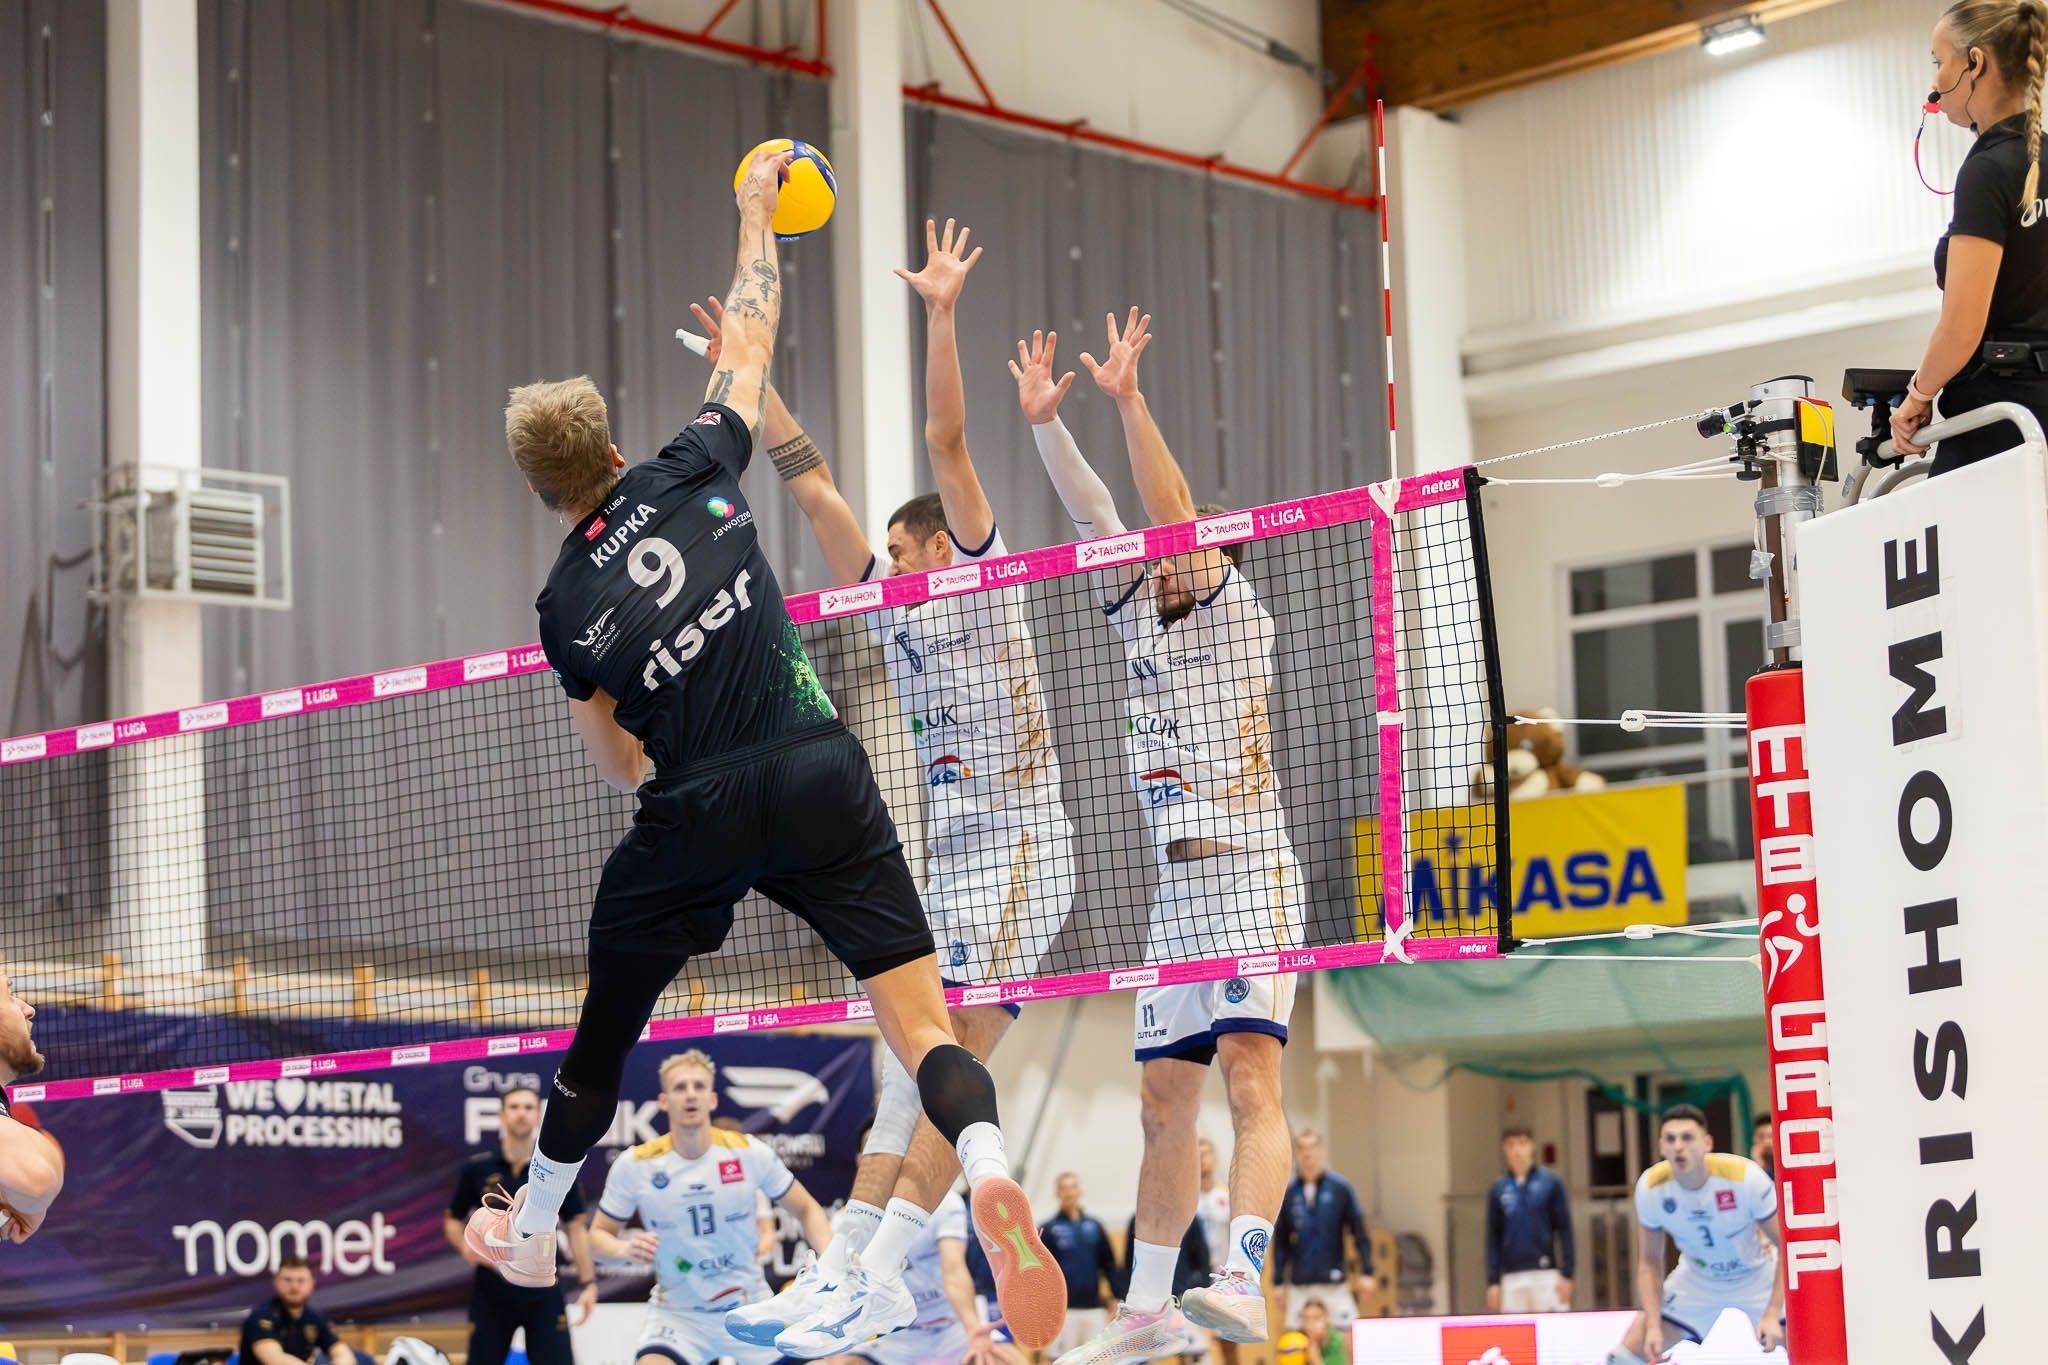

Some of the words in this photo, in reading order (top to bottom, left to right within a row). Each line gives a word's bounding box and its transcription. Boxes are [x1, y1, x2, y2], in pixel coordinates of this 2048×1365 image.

[1421, 478, 1460, 496] netex
[609, 495, 627, 511] LIGA
[1214, 521, 1250, 535] TAURON
[1270, 507, 1306, 527] LIGA
[589, 503, 658, 569] KUPKA
[1098, 541, 1138, 557] TAURON
[627, 537, 686, 610] 9
[945, 573, 978, 586] TAURON
[996, 560, 1029, 579] LIGA
[840, 591, 877, 606] TAURON
[643, 569, 751, 691] riser
[520, 650, 546, 666] LIGA
[312, 688, 338, 704] LIGA
[1459, 943, 1488, 954] netex
[1291, 953, 1317, 967] LIGA
[1125, 974, 1154, 983] TAURON
[1011, 985, 1034, 997] LIGA
[758, 1013, 780, 1025] LIGA
[1141, 1003, 1156, 1028] 11
[225, 1082, 275, 1111] WE
[306, 1081, 402, 1114] METAL
[225, 1114, 404, 1148] PROCESSING
[687, 1203, 716, 1237] 13
[172, 1211, 397, 1276] nomet
[1698, 1225, 1715, 1247] 3
